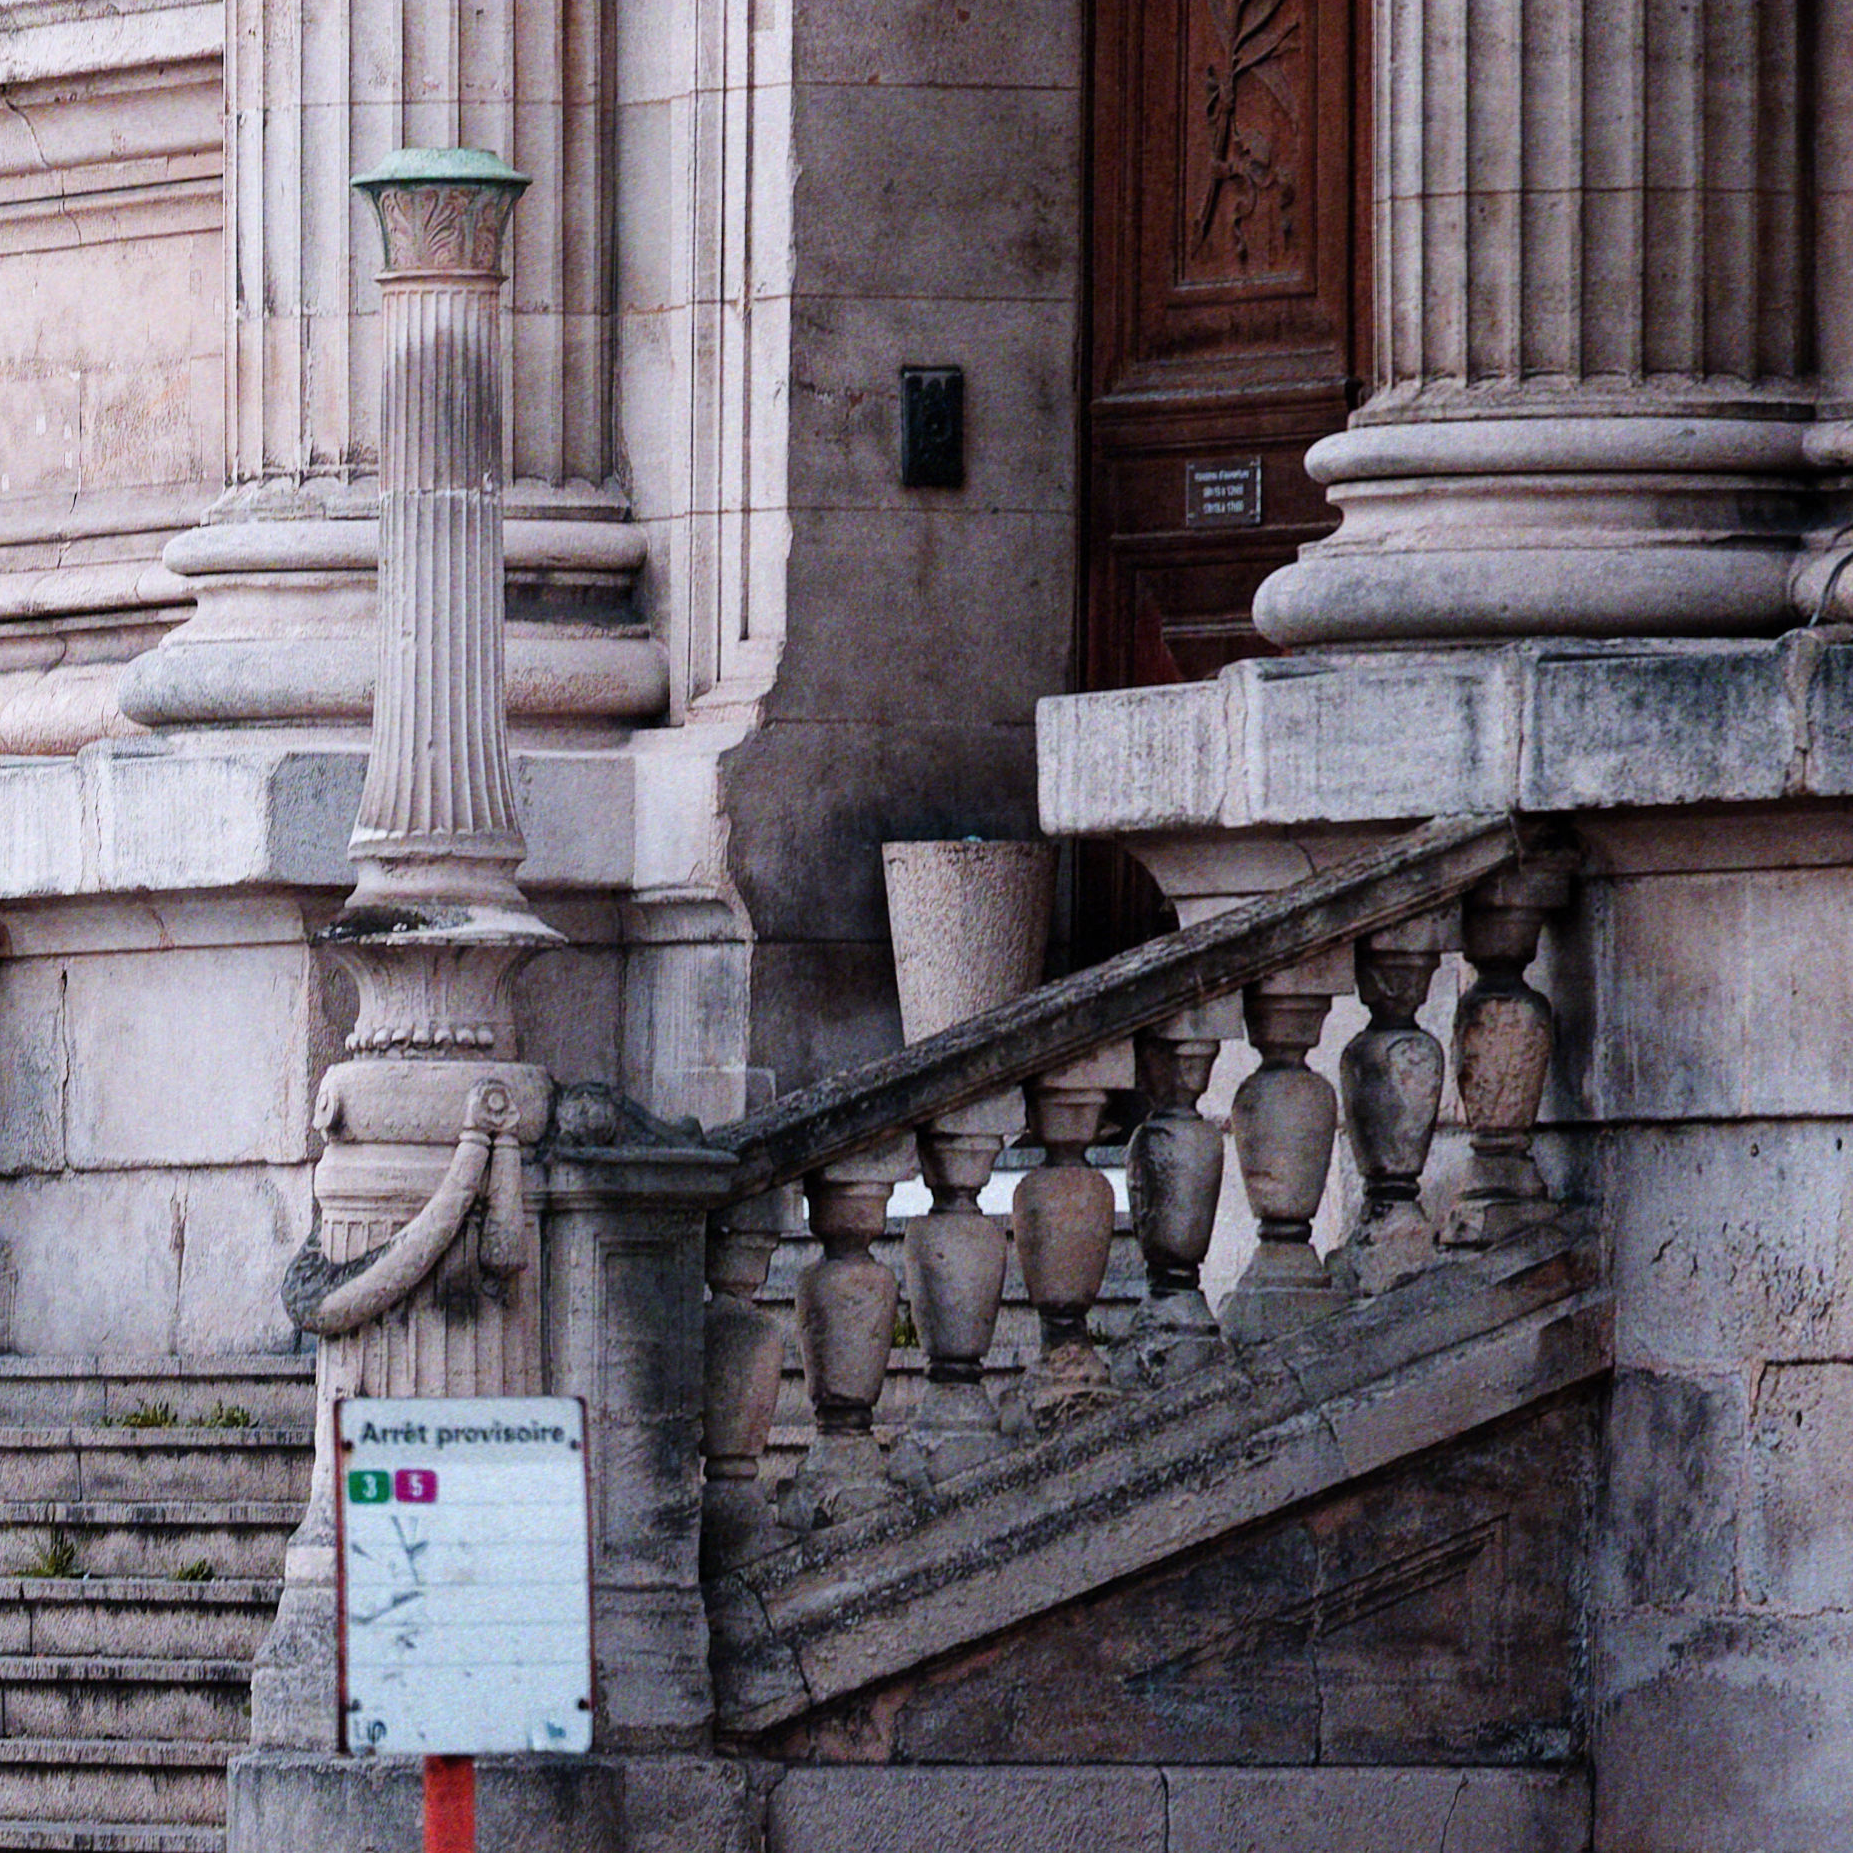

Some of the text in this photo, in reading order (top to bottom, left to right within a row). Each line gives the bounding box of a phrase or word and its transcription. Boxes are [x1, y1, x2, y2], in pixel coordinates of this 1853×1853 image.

[361, 1421, 565, 1449] Arrêt provisoire
[362, 1474, 424, 1498] 3 5
